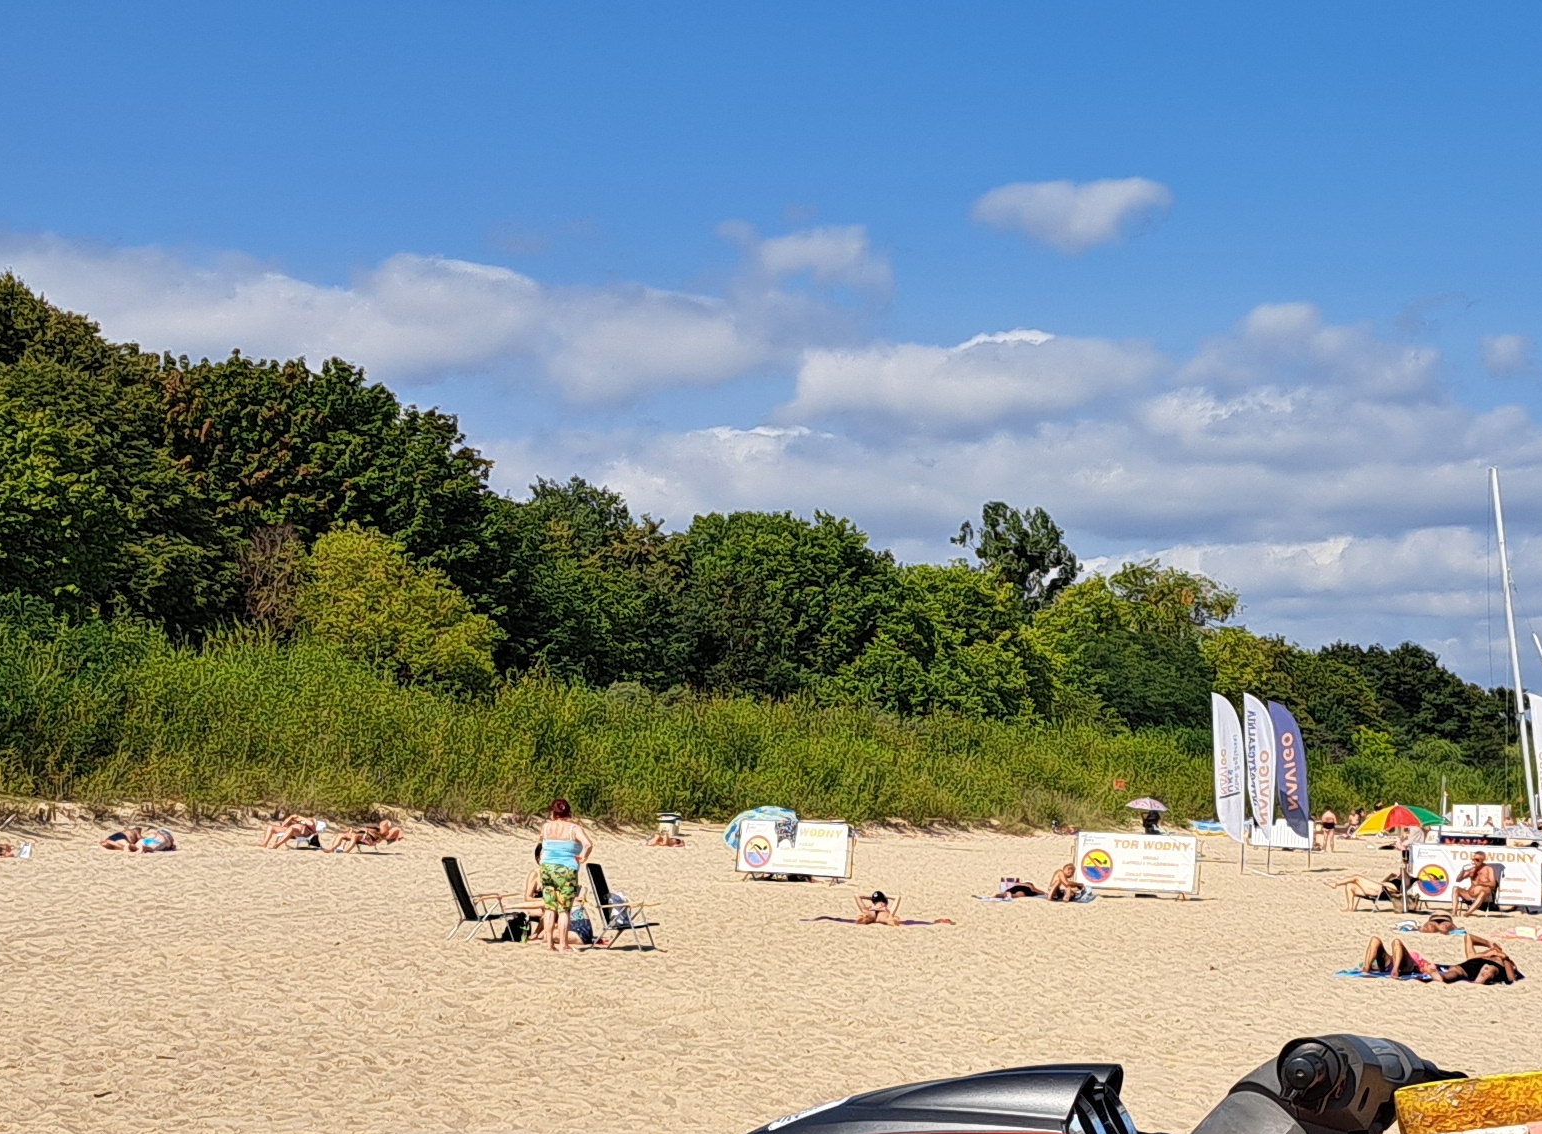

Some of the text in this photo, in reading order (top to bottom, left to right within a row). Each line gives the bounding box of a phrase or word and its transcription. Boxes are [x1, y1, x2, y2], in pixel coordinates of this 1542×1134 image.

[1114, 839, 1139, 849] TOR
[1143, 840, 1191, 852] WODNY
[1486, 851, 1536, 863] WODNY
